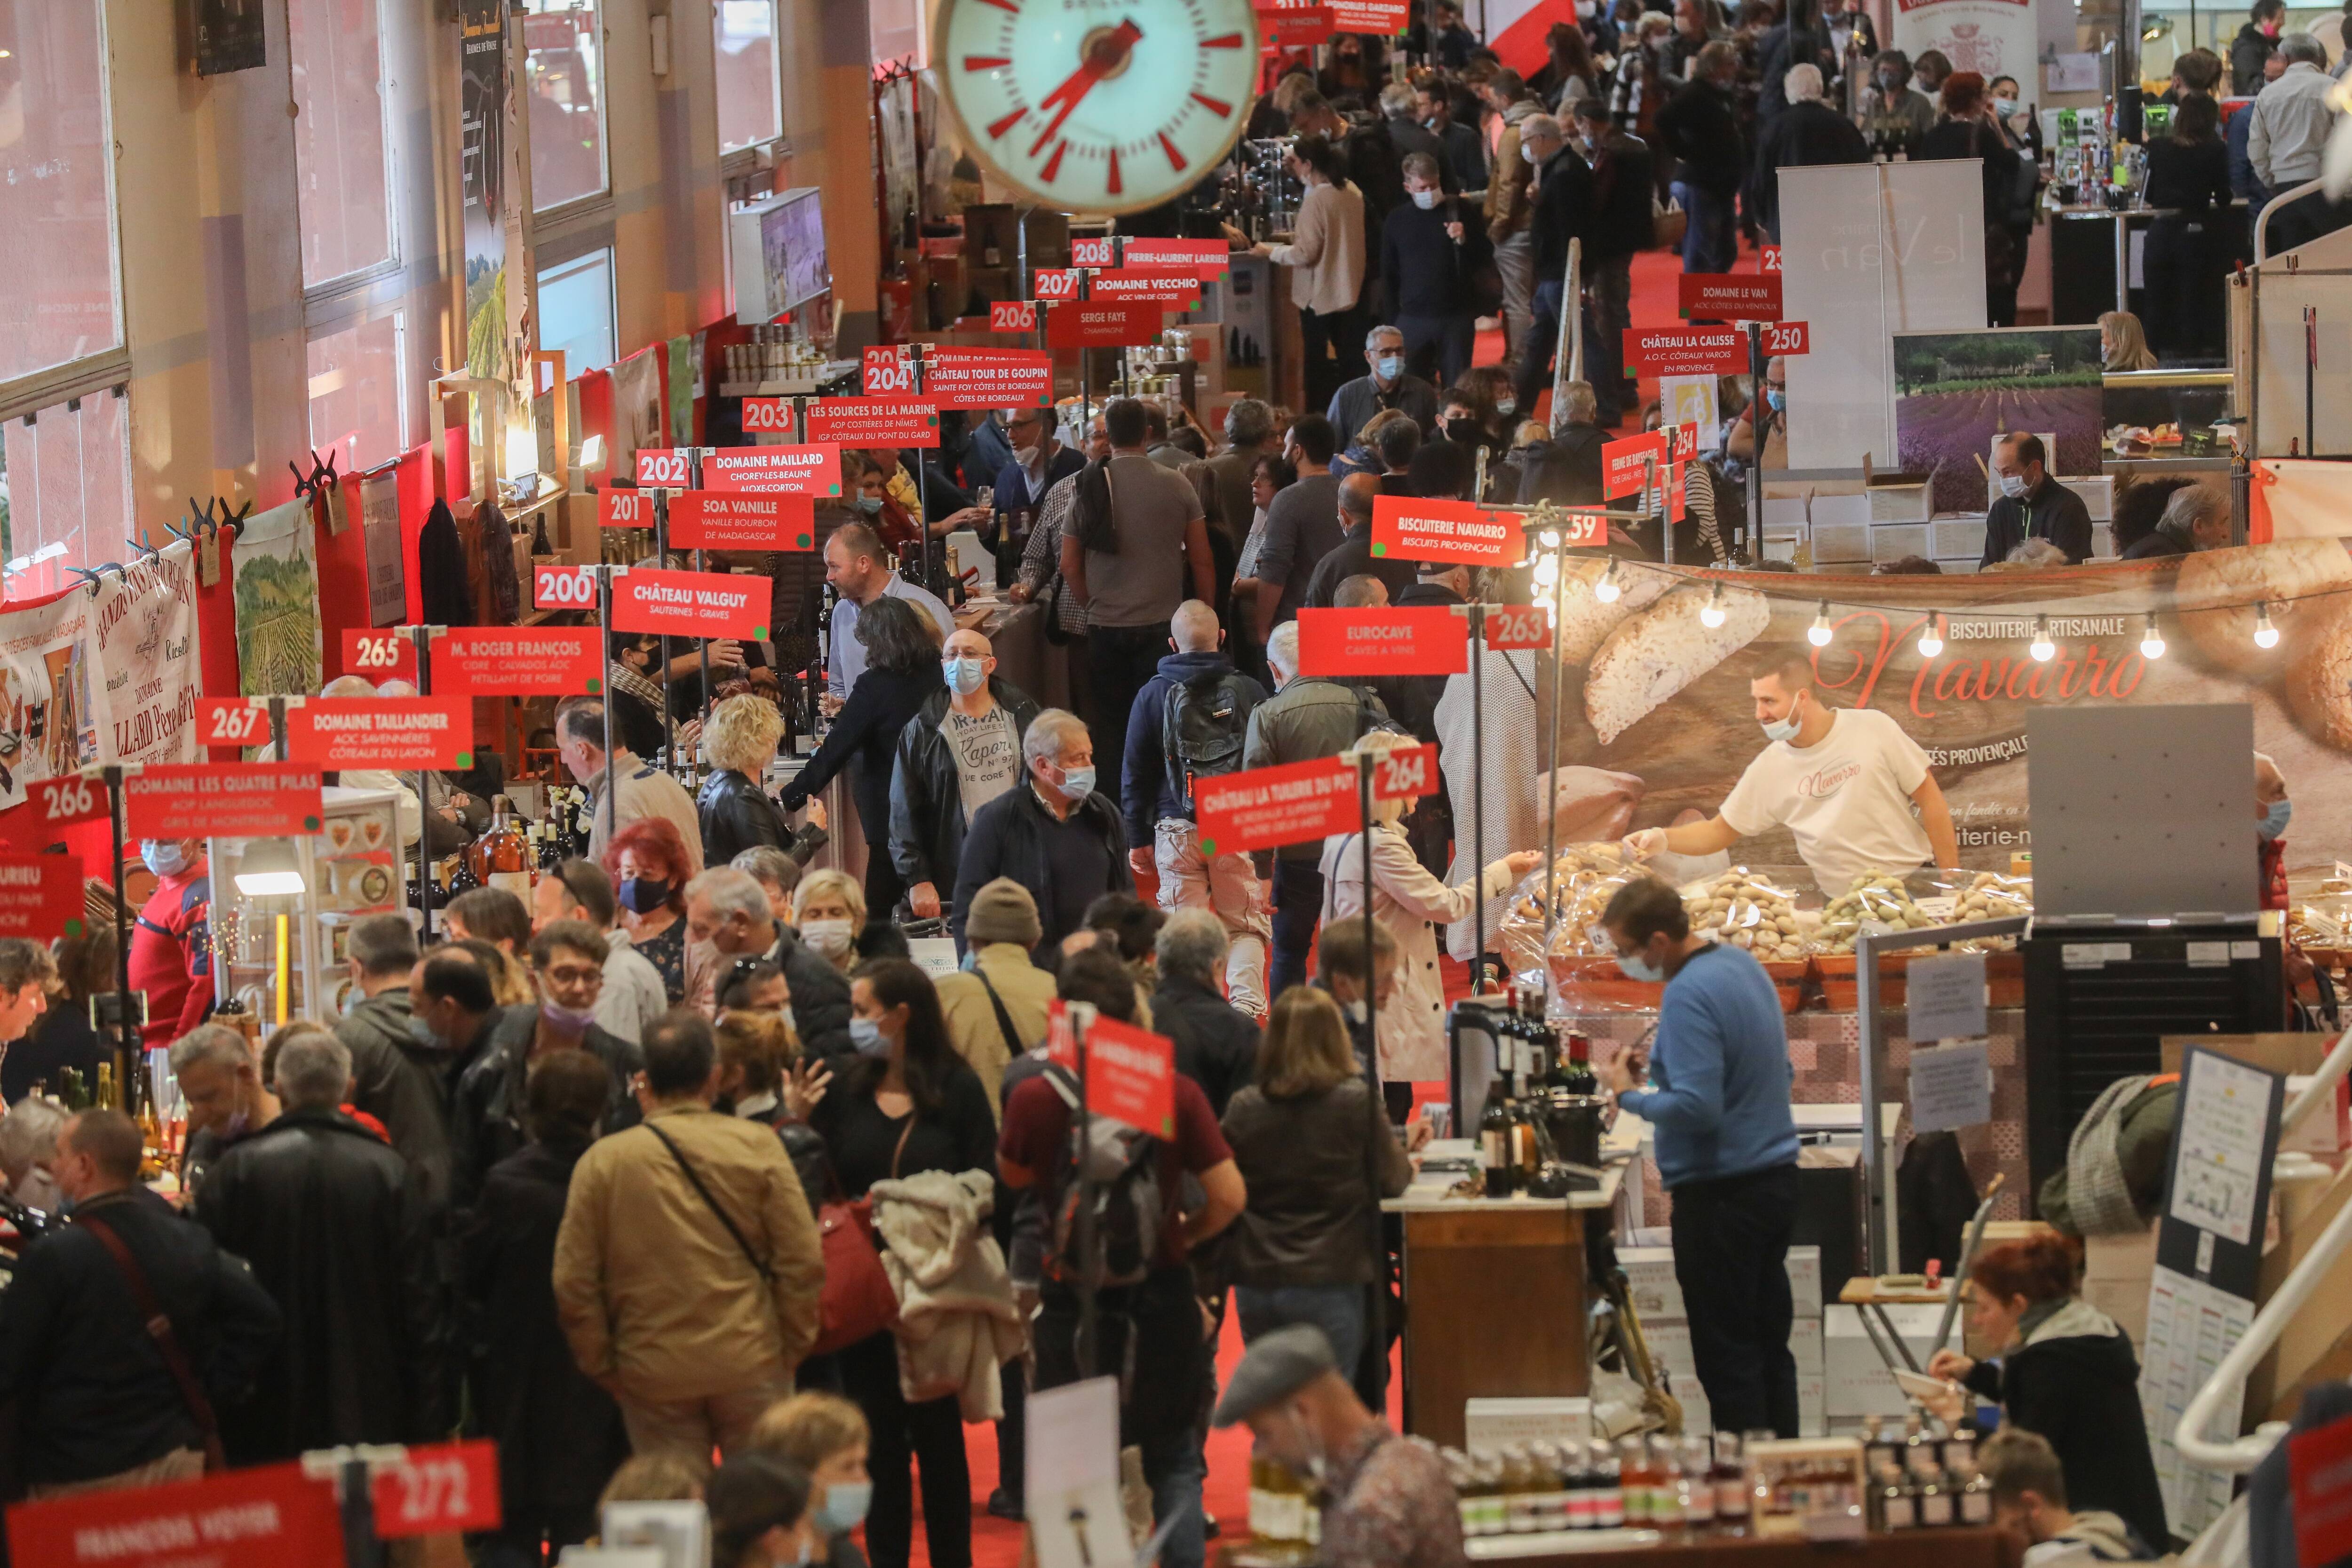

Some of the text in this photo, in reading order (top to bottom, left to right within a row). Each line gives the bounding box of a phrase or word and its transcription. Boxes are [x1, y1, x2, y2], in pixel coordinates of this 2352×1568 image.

[1075, 243, 1109, 262] 208
[1127, 252, 1228, 264] PIERRE-LAURENT LARRIEU
[1037, 274, 1076, 294] 207
[1096, 278, 1198, 290] DOMAINE VECCHIO
[1703, 287, 1767, 298] DOMAINE LE VAN
[995, 307, 1032, 327] 206
[1081, 312, 1126, 323] SERGE FAYE
[1641, 334, 1734, 348] CHÂTEAU LA CALISSE
[1771, 328, 1801, 350] 250
[1670, 351, 1703, 360] CÔTEAUX
[868, 367, 908, 390] 204
[930, 367, 1048, 380] CHÂTEAU TOUR DE GOUPIN
[974, 381, 995, 390] CÔTES
[954, 393, 975, 403] CÔTES
[746, 404, 788, 428] 203
[811, 404, 936, 417] LES SOURCES DE LA MARINE
[847, 419, 883, 428] COSTIÈRES
[896, 418, 917, 427] NÎMES
[832, 430, 864, 440] CÔTEAUX
[1677, 430, 1693, 455] 254
[641, 456, 685, 481] 202
[716, 453, 823, 469] DOMAINE MAILLARD
[1612, 455, 1632, 471] FERME DE
[731, 470, 811, 481] CHOREY-LES-BEAUNE
[1612, 473, 1631, 484] FOIE GRAS
[611, 495, 638, 520] 201
[703, 500, 778, 514] SOA VANILLE
[1398, 517, 1506, 539] BISCUITERIE NAVARRO
[1565, 515, 1596, 539] 59
[1402, 537, 1501, 554] BISCUITS PROVENÇAUX
[539, 573, 591, 602] 200
[634, 583, 747, 607] CHÂTEAU VALGUY
[649, 605, 729, 620] SAUTERNES GRAVES
[1346, 626, 1413, 640] EUROCAVE
[1497, 613, 1543, 642] 263
[1950, 618, 2125, 640] BISCUITERIE RTISANALE
[356, 637, 399, 667] 265
[451, 641, 581, 660] M. ROGER FRANÇOIS
[1345, 646, 1377, 655] CAVES
[1391, 645, 1415, 655] VINS
[462, 661, 570, 670] CIDRE CALVADOS AOC
[1809, 611, 2145, 718] Navarro
[520, 674, 532, 683] DE
[534, 674, 562, 684] POIRE
[135, 677, 162, 704] DOMAINE
[211, 708, 258, 738] 267
[314, 713, 448, 730] DOMAINE TAILLANDIER
[113, 709, 153, 757] LLARD
[333, 732, 431, 744] AOC SAVENNIÈRES
[329, 747, 436, 760] CÔTEAUX DU LAYON
[981, 770, 1004, 781] CORE
[1385, 756, 1425, 793] 264
[129, 774, 317, 795] DOMAINE LES QUATRE PILAS
[1204, 788, 1253, 814] CHÂTEAU
[1256, 788, 1269, 805] LA
[1316, 777, 1332, 794] DU
[1334, 772, 1355, 791] PUY
[44, 781, 93, 820] 266
[1963, 802, 2002, 822] fondée
[192, 817, 207, 828] DE
[1955, 826, 2032, 846] iterie-n
